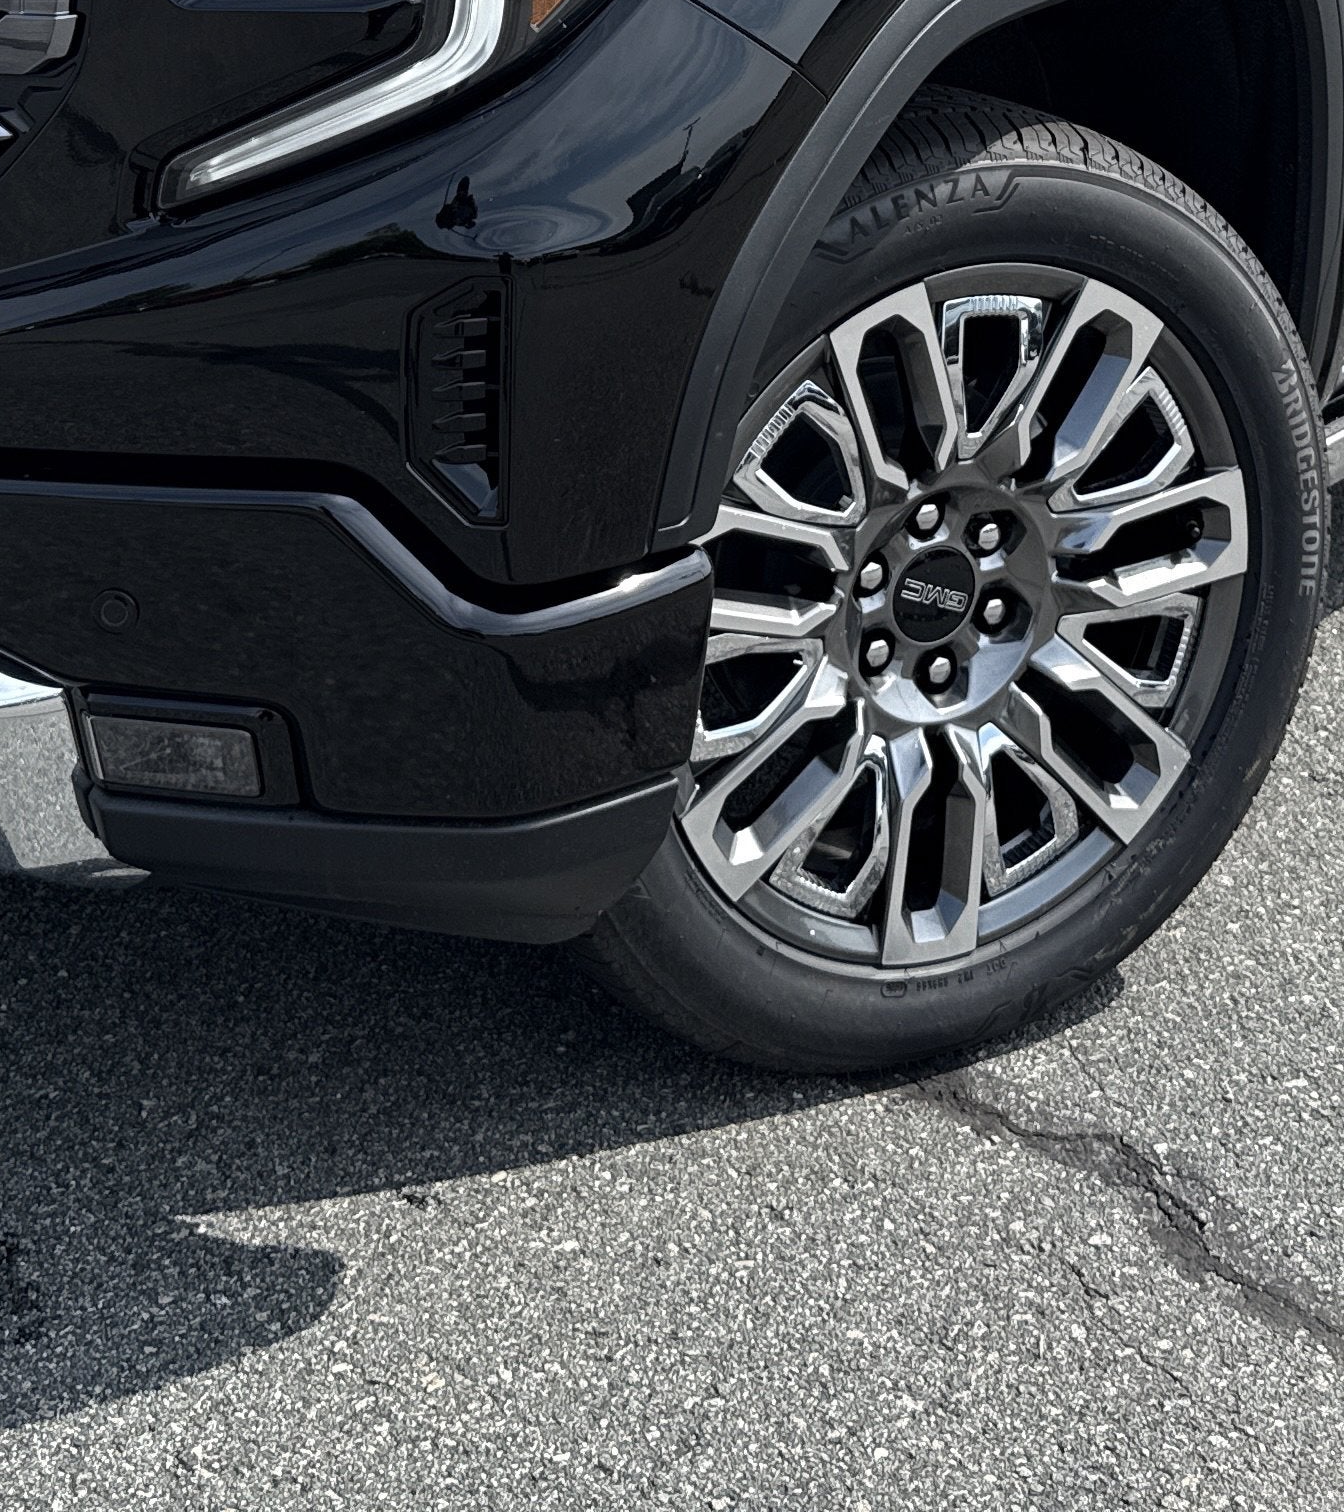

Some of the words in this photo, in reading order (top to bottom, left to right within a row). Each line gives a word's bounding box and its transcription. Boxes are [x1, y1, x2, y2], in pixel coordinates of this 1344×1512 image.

[848, 173, 991, 241] ALENZA
[1272, 359, 1321, 597] BRIDGESTONE
[900, 578, 969, 612] GMC
